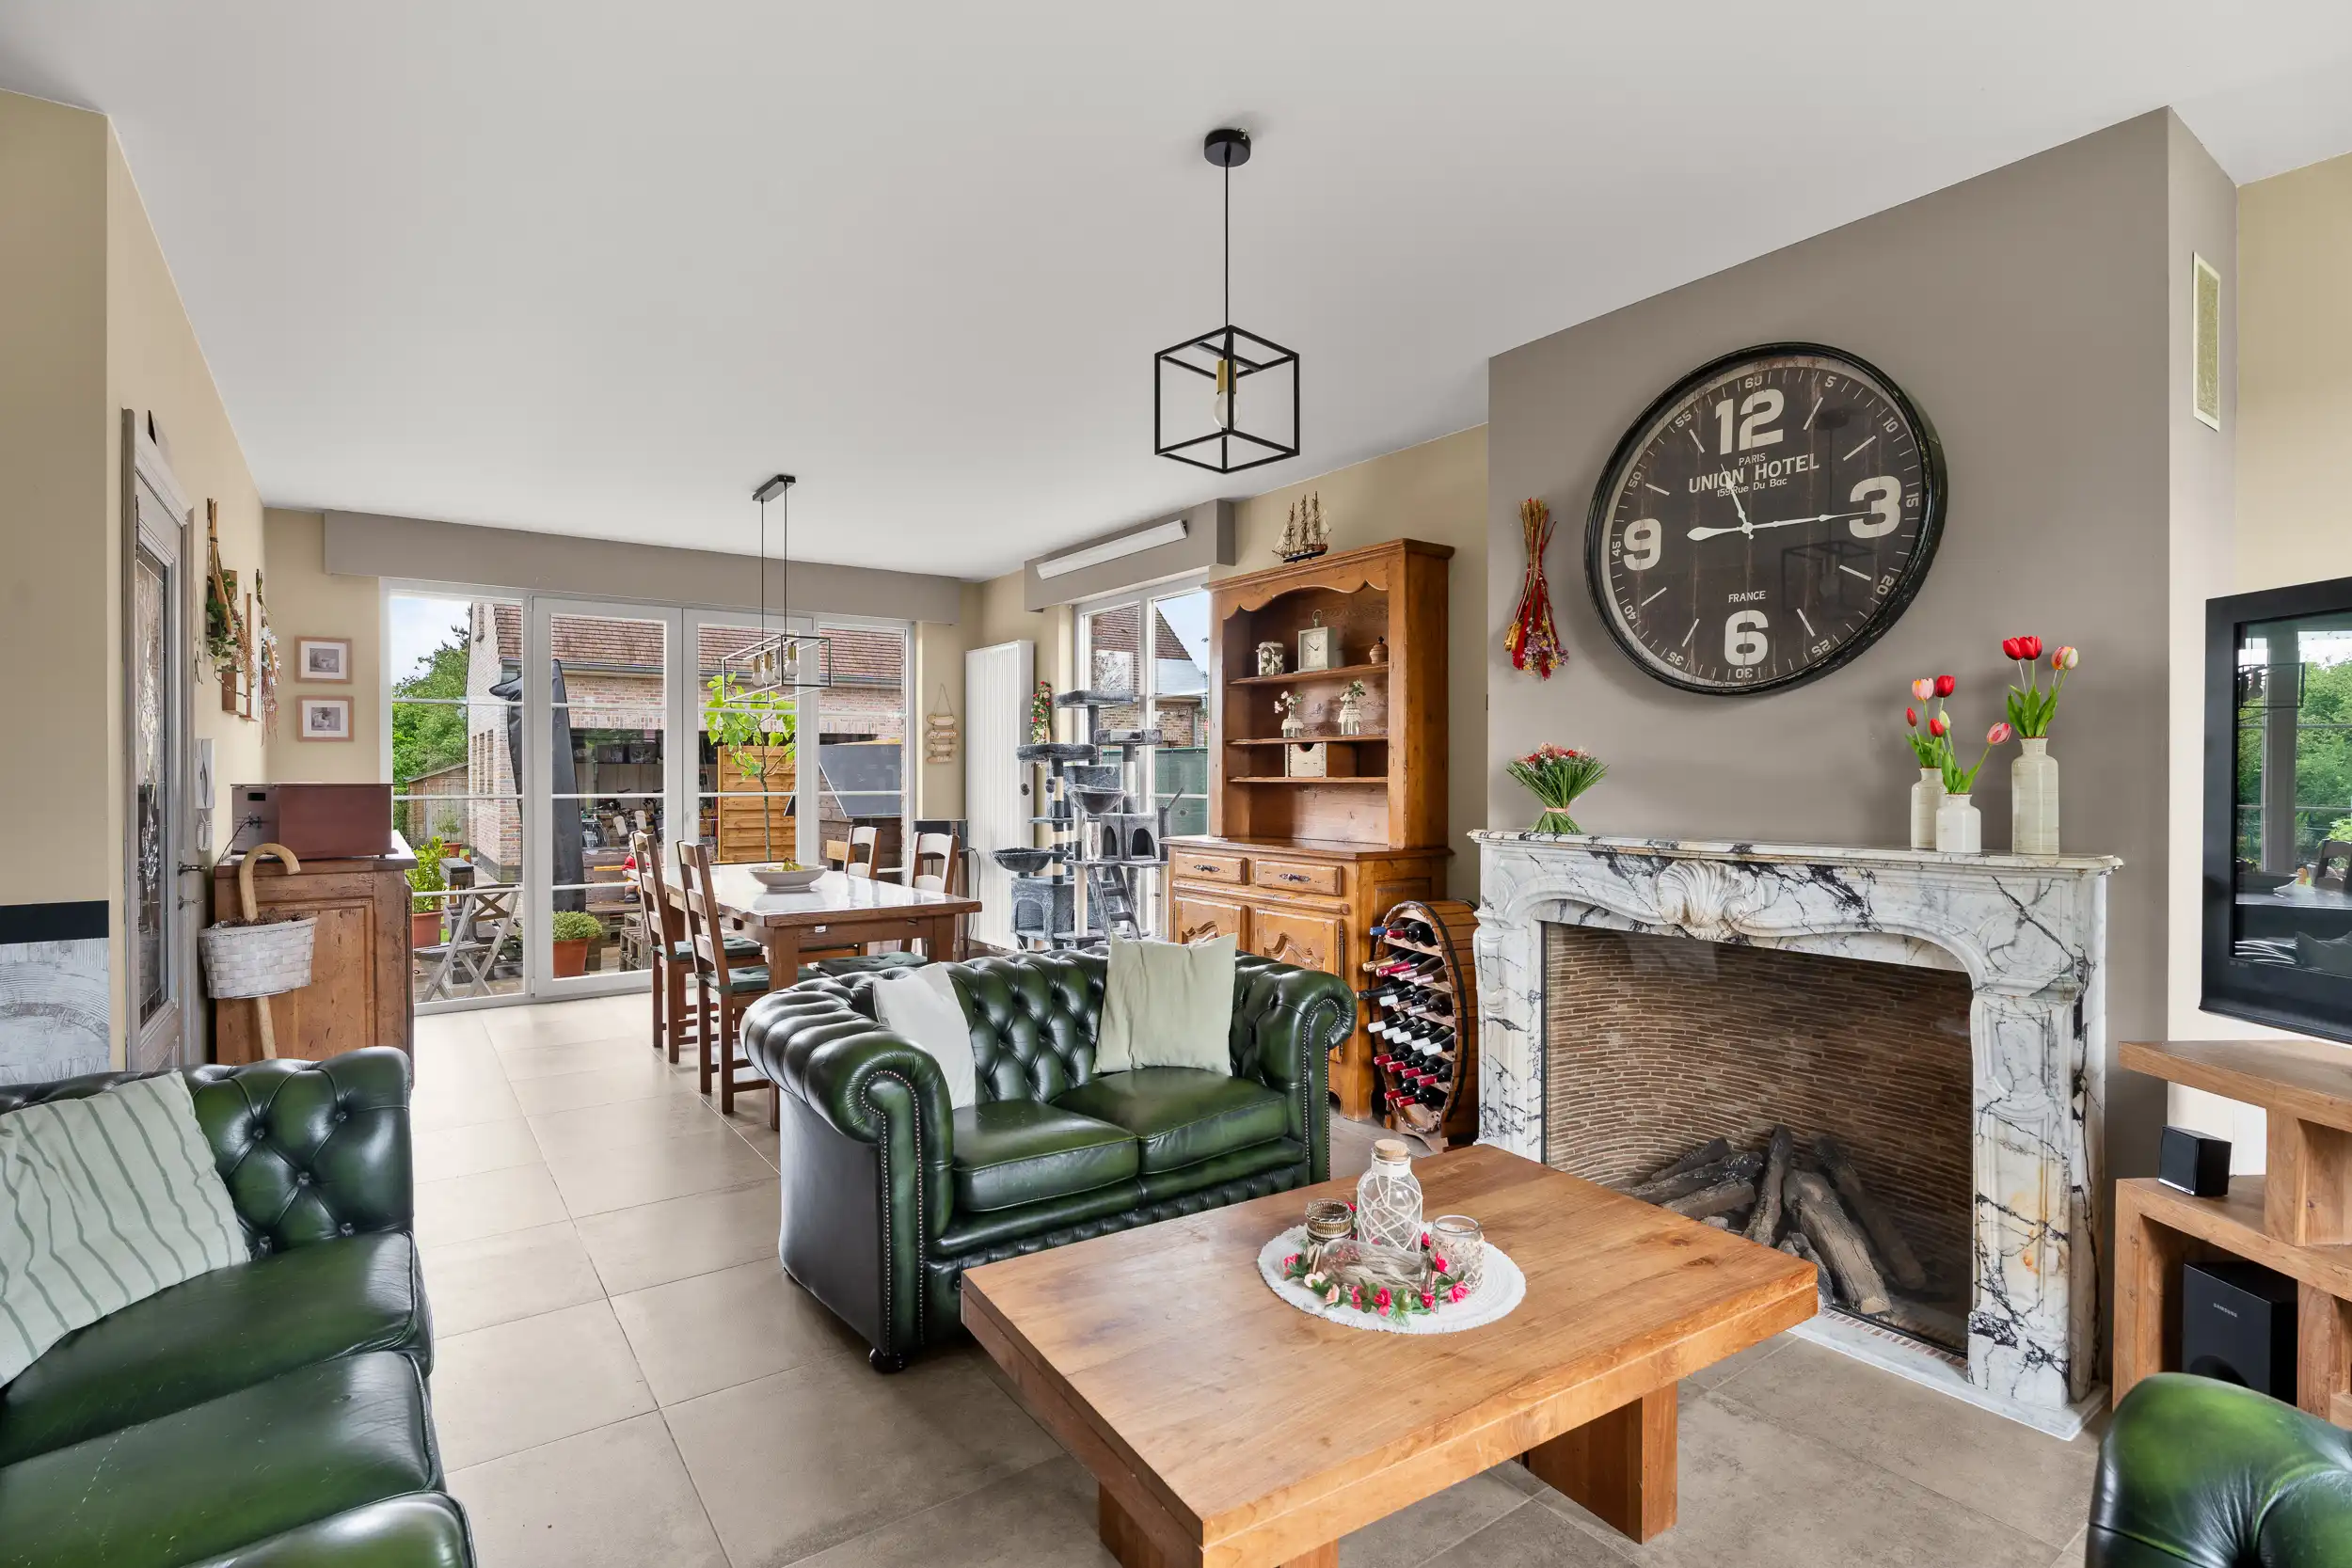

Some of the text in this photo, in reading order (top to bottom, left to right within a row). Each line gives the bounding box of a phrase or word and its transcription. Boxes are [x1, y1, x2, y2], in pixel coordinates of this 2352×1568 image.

[1744, 375, 1763, 389] 60
[1824, 375, 1837, 388] 5
[1675, 410, 1692, 428] 55
[1715, 388, 1785, 455] 12
[1883, 417, 1899, 434] 10
[1739, 452, 1766, 467] PARIS
[1629, 471, 1643, 489] 50
[1688, 452, 1820, 494] UNION HOTEL
[1732, 484, 1749, 495] Rue
[1753, 481, 1766, 491] Du
[1769, 477, 1788, 488] Bac
[1849, 475, 1902, 539] 3
[1906, 492, 1919, 508] 15
[1612, 541, 1622, 557] 45
[1623, 518, 1662, 571] 9
[1876, 574, 1895, 595] 20
[1728, 590, 1767, 603] FRANCE
[1624, 605, 1637, 621] 40
[1724, 610, 1769, 666] 6
[1811, 639, 1832, 657] 25
[1666, 651, 1684, 666] 35
[1735, 668, 1753, 678] 30
